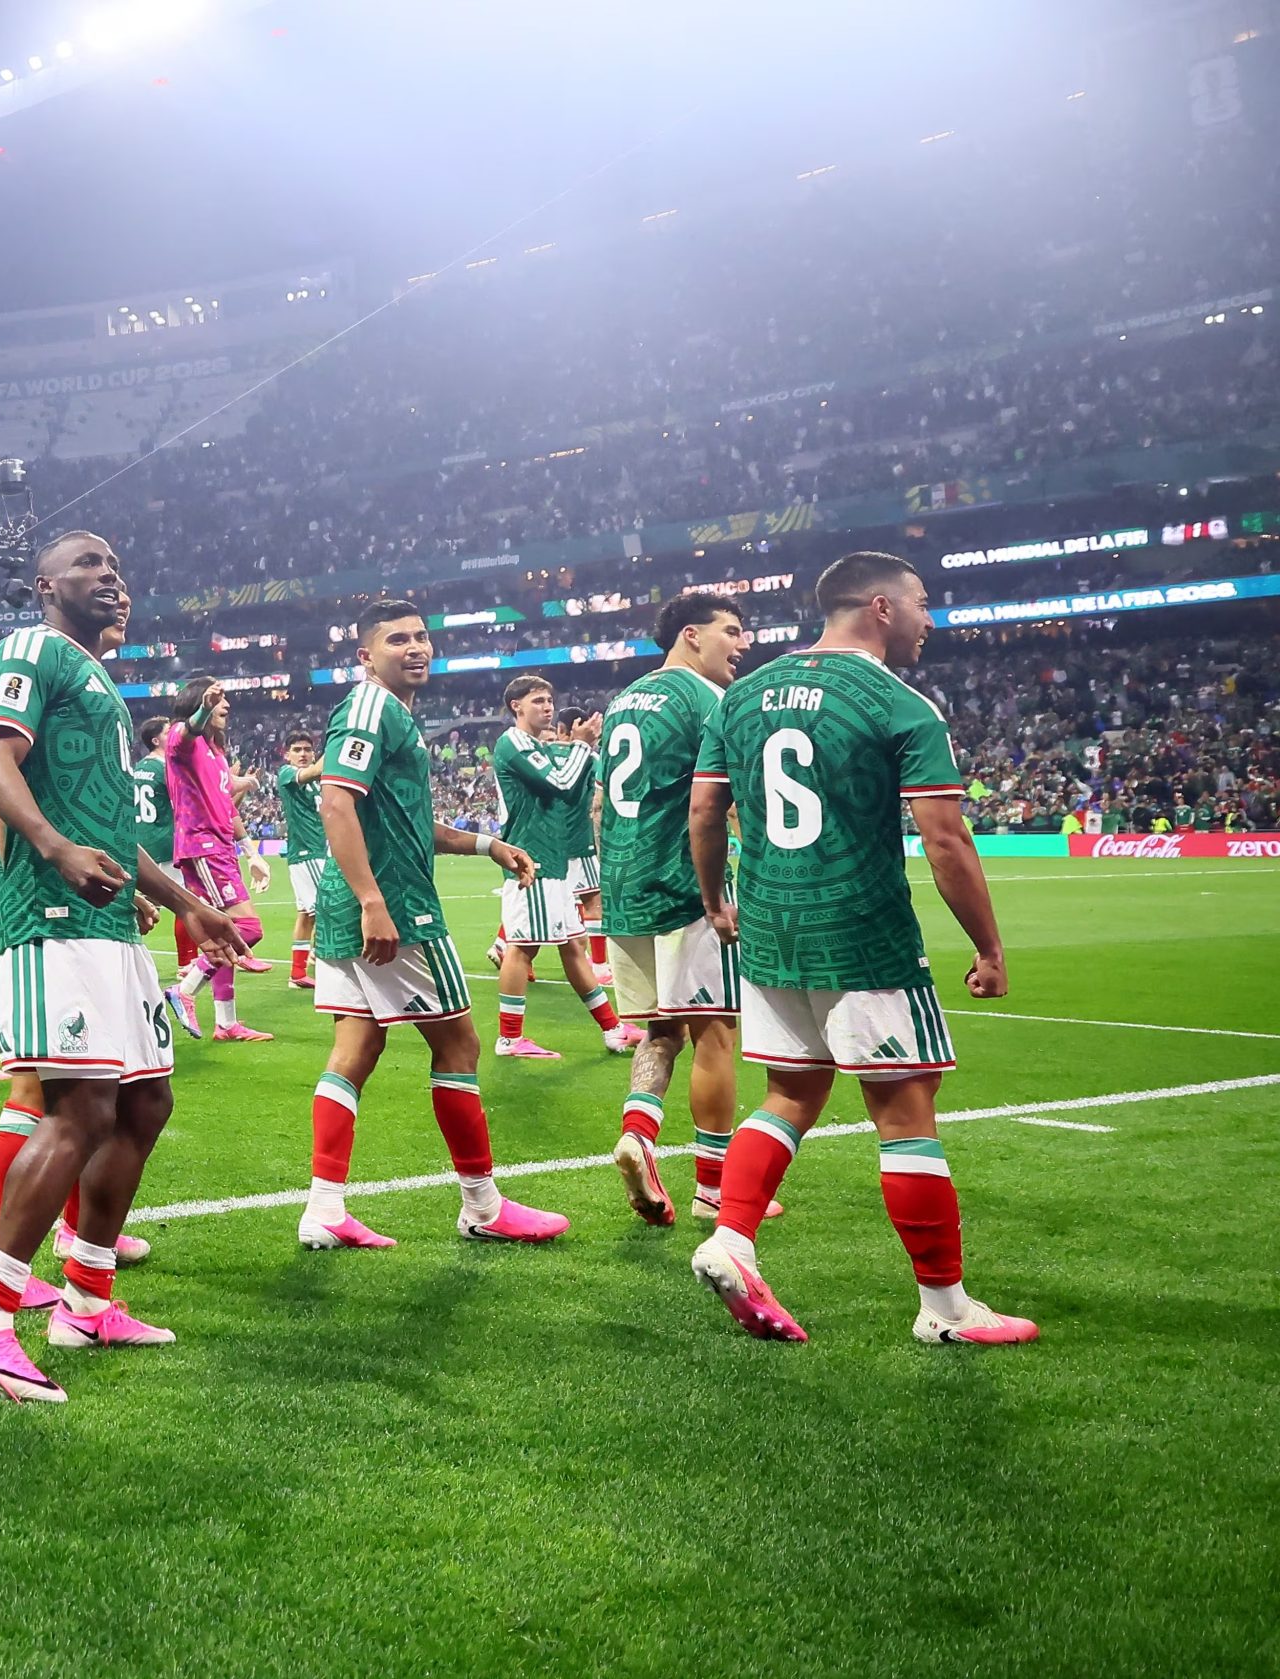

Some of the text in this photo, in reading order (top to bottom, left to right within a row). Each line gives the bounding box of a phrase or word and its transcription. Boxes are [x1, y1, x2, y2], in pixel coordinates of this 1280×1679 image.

[25, 375, 104, 396] WORLD
[108, 367, 150, 387] CUP
[154, 356, 231, 381] 2026
[792, 381, 836, 398] CITY
[941, 549, 987, 570] COPA
[988, 542, 1063, 565] MUNDIAL
[1063, 538, 1090, 555] DE
[1090, 534, 1115, 552] LA
[752, 573, 794, 593] CITY
[18, 609, 43, 621] CIT
[948, 606, 995, 626] COPA
[995, 599, 1071, 622] MUNDIAL
[1071, 595, 1098, 612] DE
[1097, 593, 1123, 610] LA
[1122, 588, 1166, 608] FIFA
[757, 625, 800, 644] CITY
[761, 685, 824, 713] E.LIRA
[608, 722, 643, 818] 2
[762, 728, 823, 850] 6
[1092, 833, 1185, 858] Coca-Cola
[1226, 841, 1280, 857] zero
